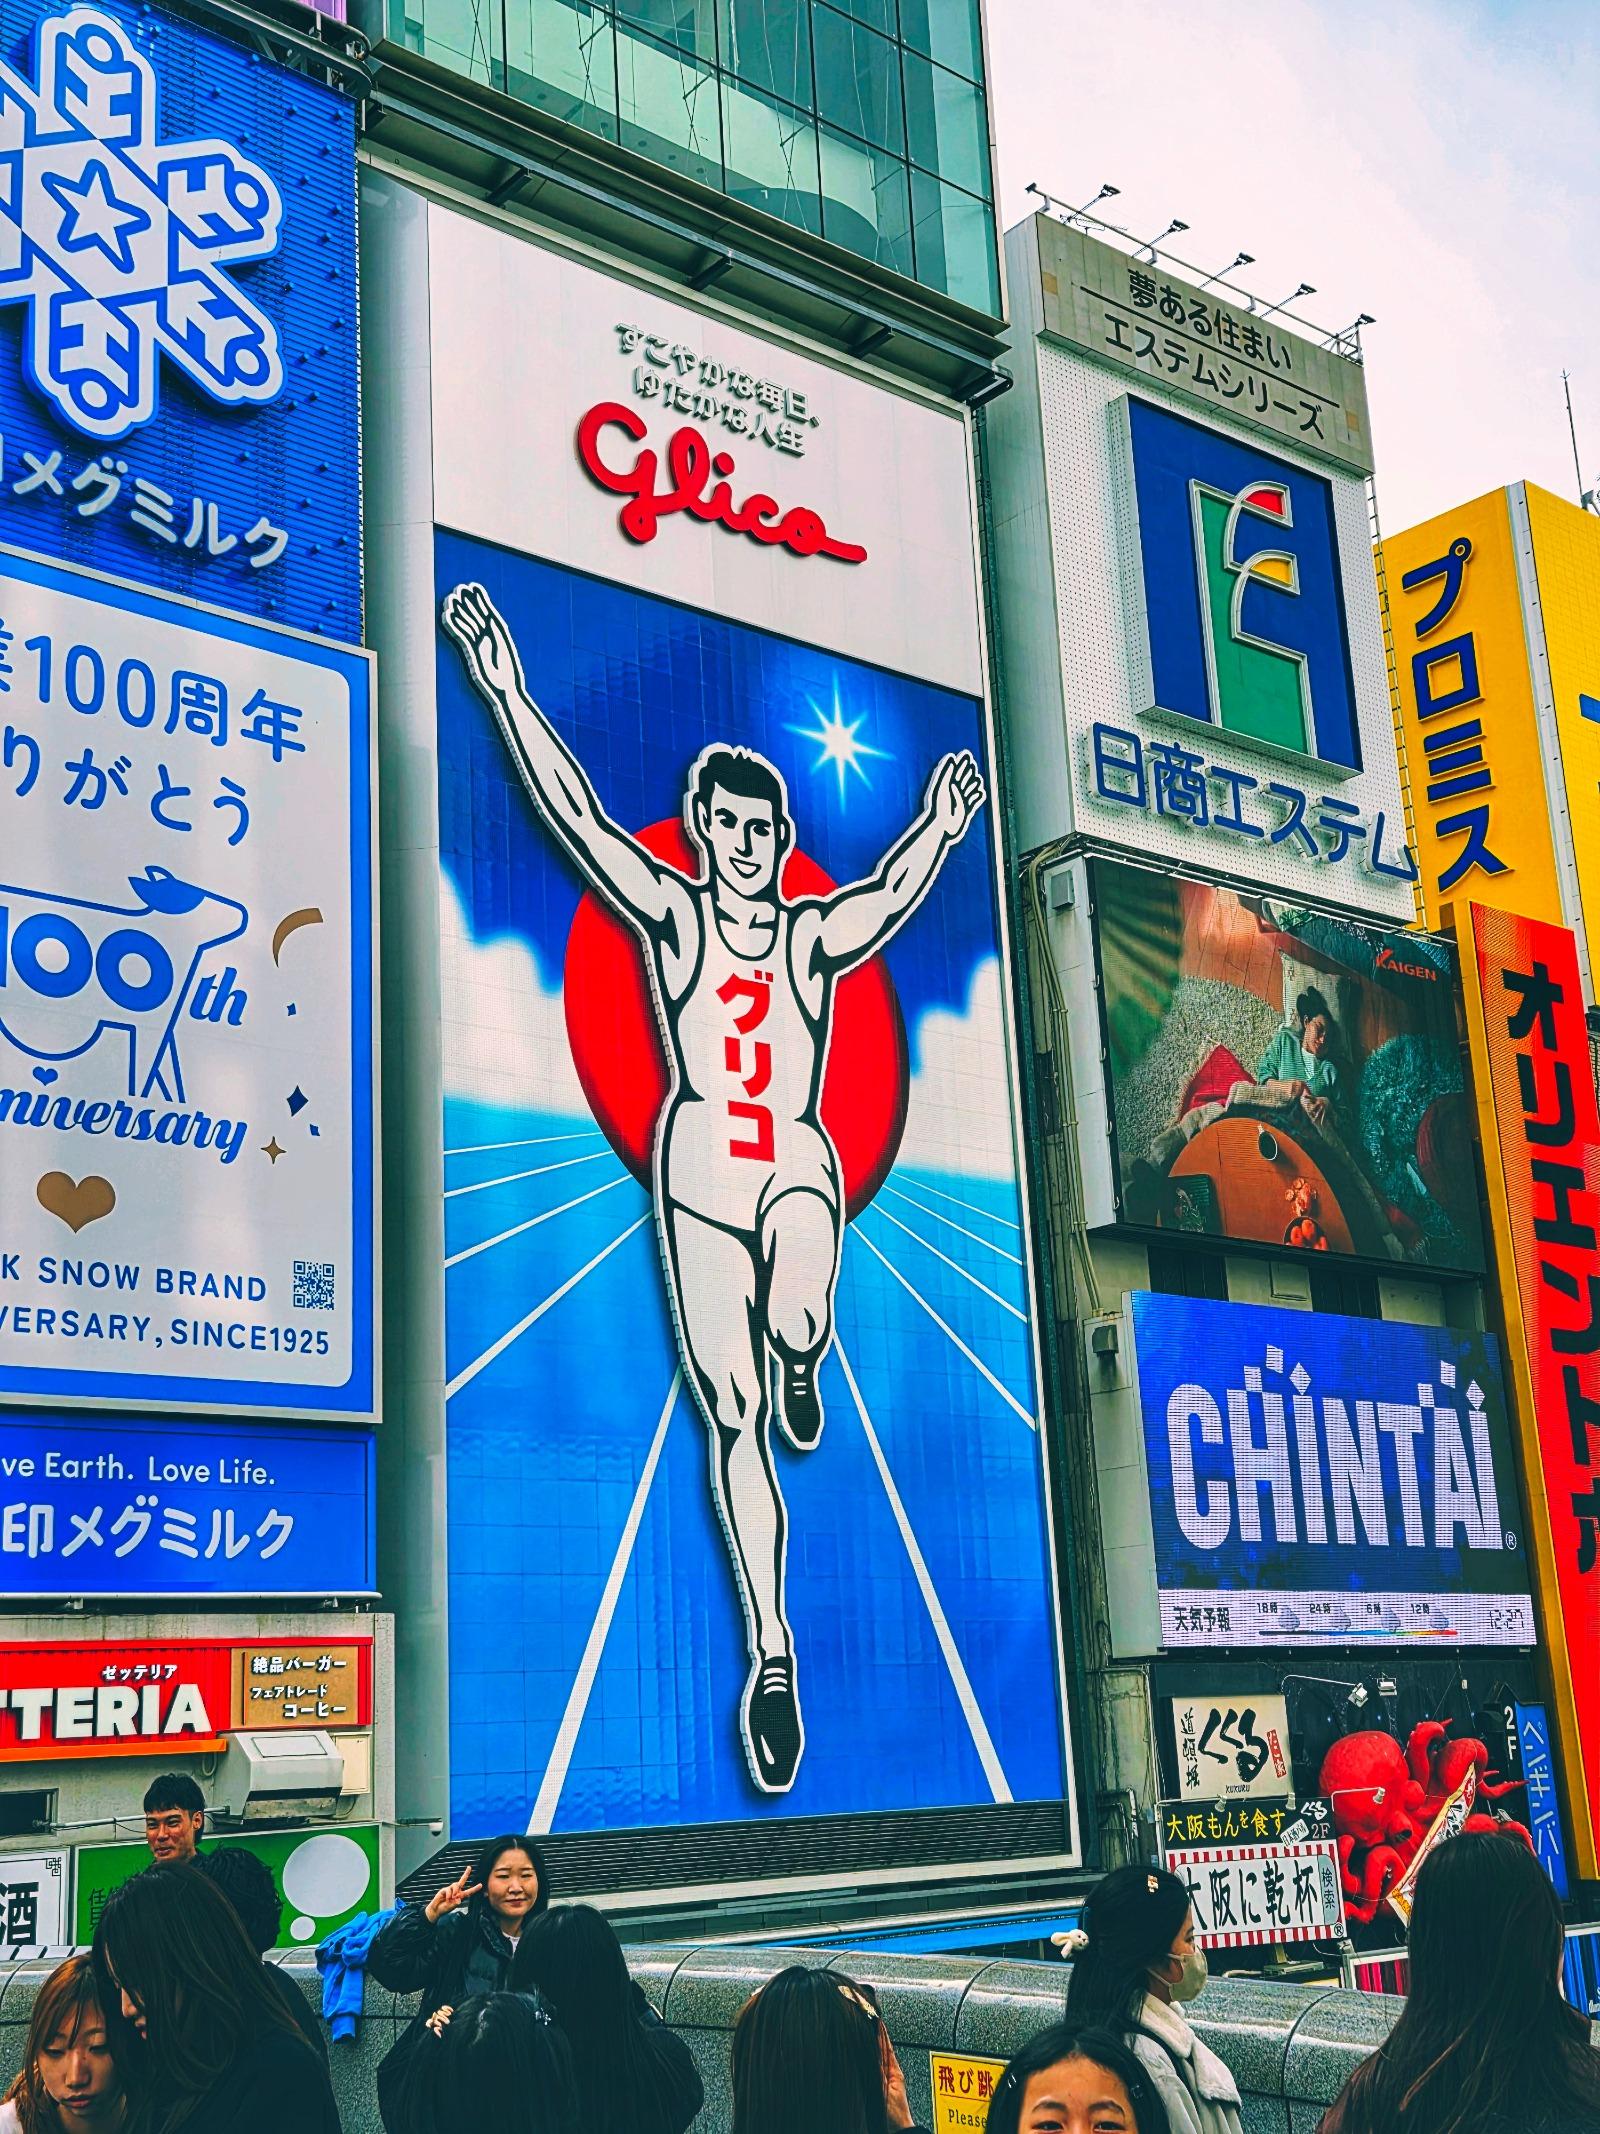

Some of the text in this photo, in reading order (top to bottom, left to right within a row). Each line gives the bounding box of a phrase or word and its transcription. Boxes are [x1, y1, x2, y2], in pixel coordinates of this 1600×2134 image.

[1127, 269, 1291, 370] 夢ある住まい
[615, 322, 821, 428] すこやかな毎日、
[1105, 313, 1324, 440] エステムシリーズ
[633, 366, 806, 457] ゆたかな人生
[0, 432, 289, 568] メグミルク
[577, 402, 867, 563] Glico
[1402, 537, 1511, 895] プロミス
[1091, 722, 1419, 881] 日商エステム
[1375, 948, 1437, 982] KAIGEN
[716, 969, 775, 1162] グリコ
[39, 1257, 140, 1291] SNOW
[156, 1268, 267, 1302] BRAND
[45, 1452, 134, 1481] Earth.
[149, 1456, 211, 1484] Love
[219, 1458, 275, 1486] Life.
[2, 1494, 295, 1560] 印メグミルク
[1173, 1605, 1232, 1632] 天気予報
[102, 1663, 178, 1680] ゼッテリア
[251, 1684, 329, 1700] フェアトレード
[252, 1654, 347, 1674] 絶品バーガー
[0, 1683, 212, 1740] TERIA
[284, 1701, 347, 1718] コーヒー
[1198, 1708, 1270, 1783] くくる
[1166, 1808, 1286, 1842] 大阪もんを食す
[1311, 1822, 1331, 1839] 2F
[1523, 1721, 1560, 1883] ペンギンバー
[1186, 1859, 1318, 1931] 大阪に乾杯
[1321, 1866, 1336, 1910] 検索
[948, 2108, 988, 2129] Please
